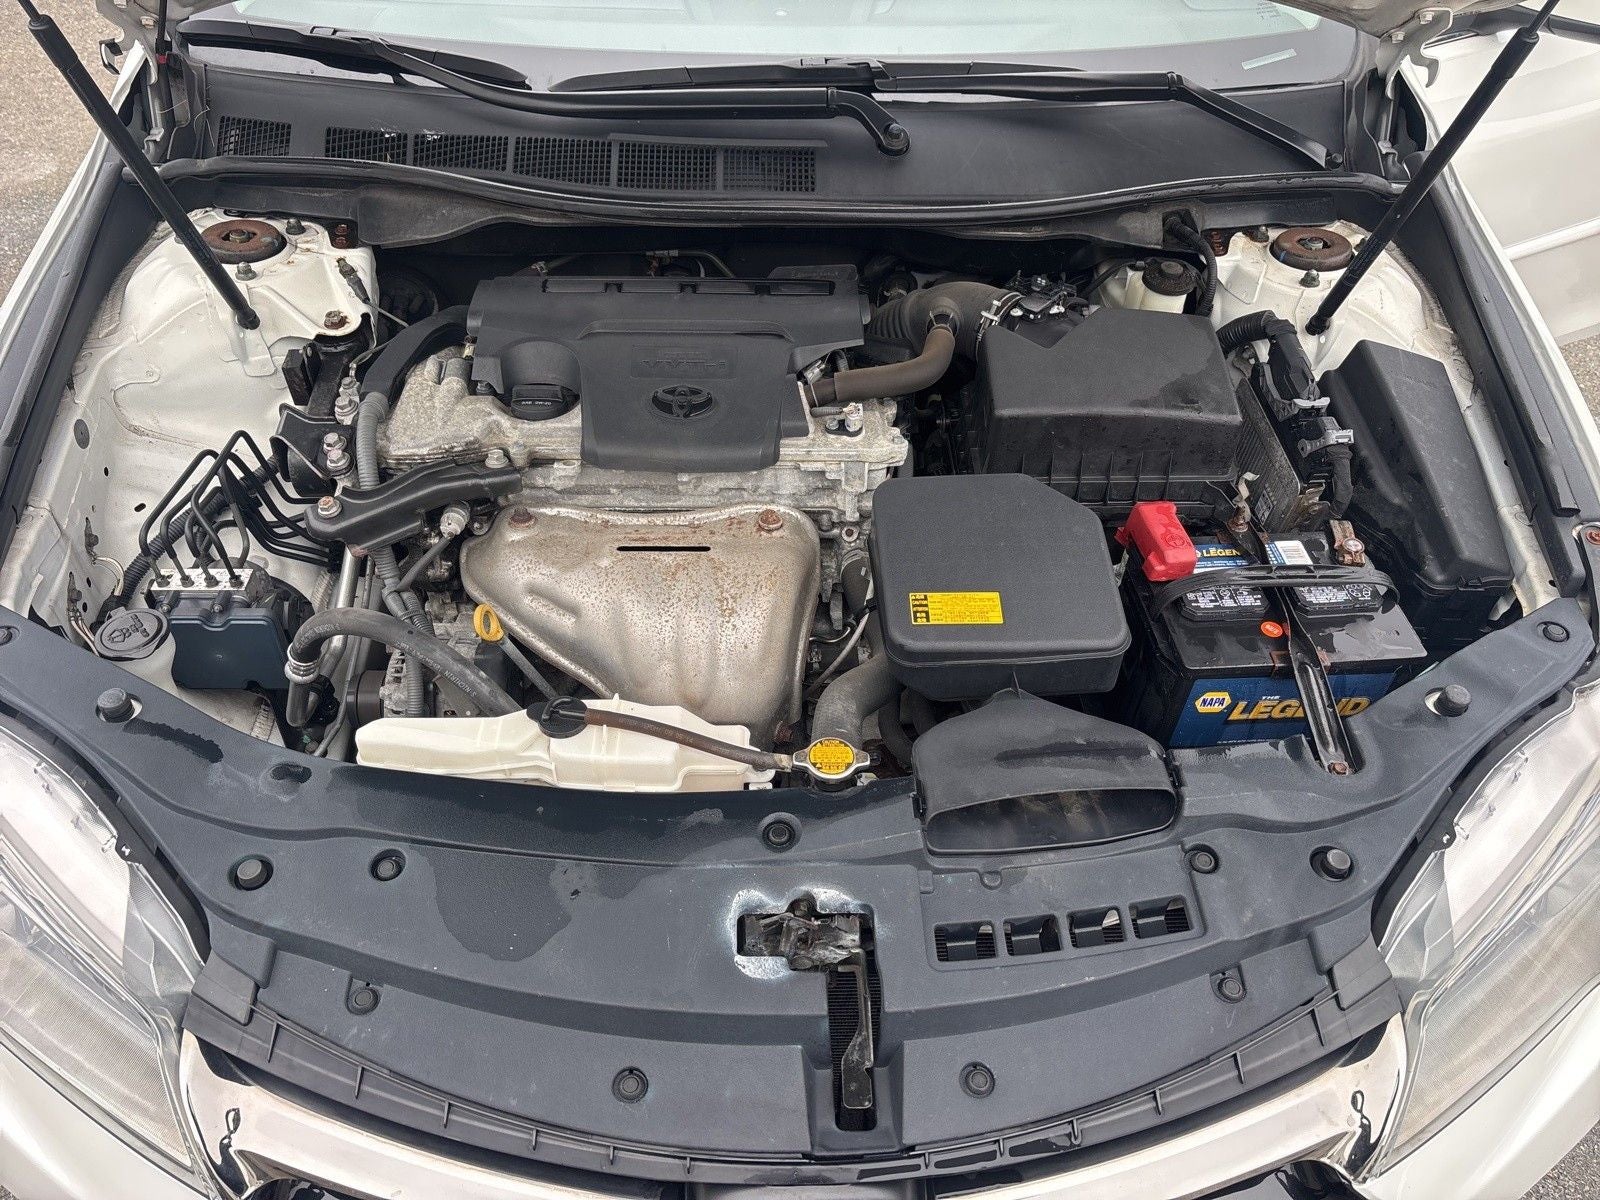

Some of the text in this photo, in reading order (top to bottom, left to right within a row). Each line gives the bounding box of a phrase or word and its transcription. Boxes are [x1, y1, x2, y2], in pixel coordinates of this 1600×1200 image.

[1202, 548, 1241, 557] LEGEN
[1200, 696, 1225, 707] NAPA
[1227, 697, 1371, 721] LEGD
